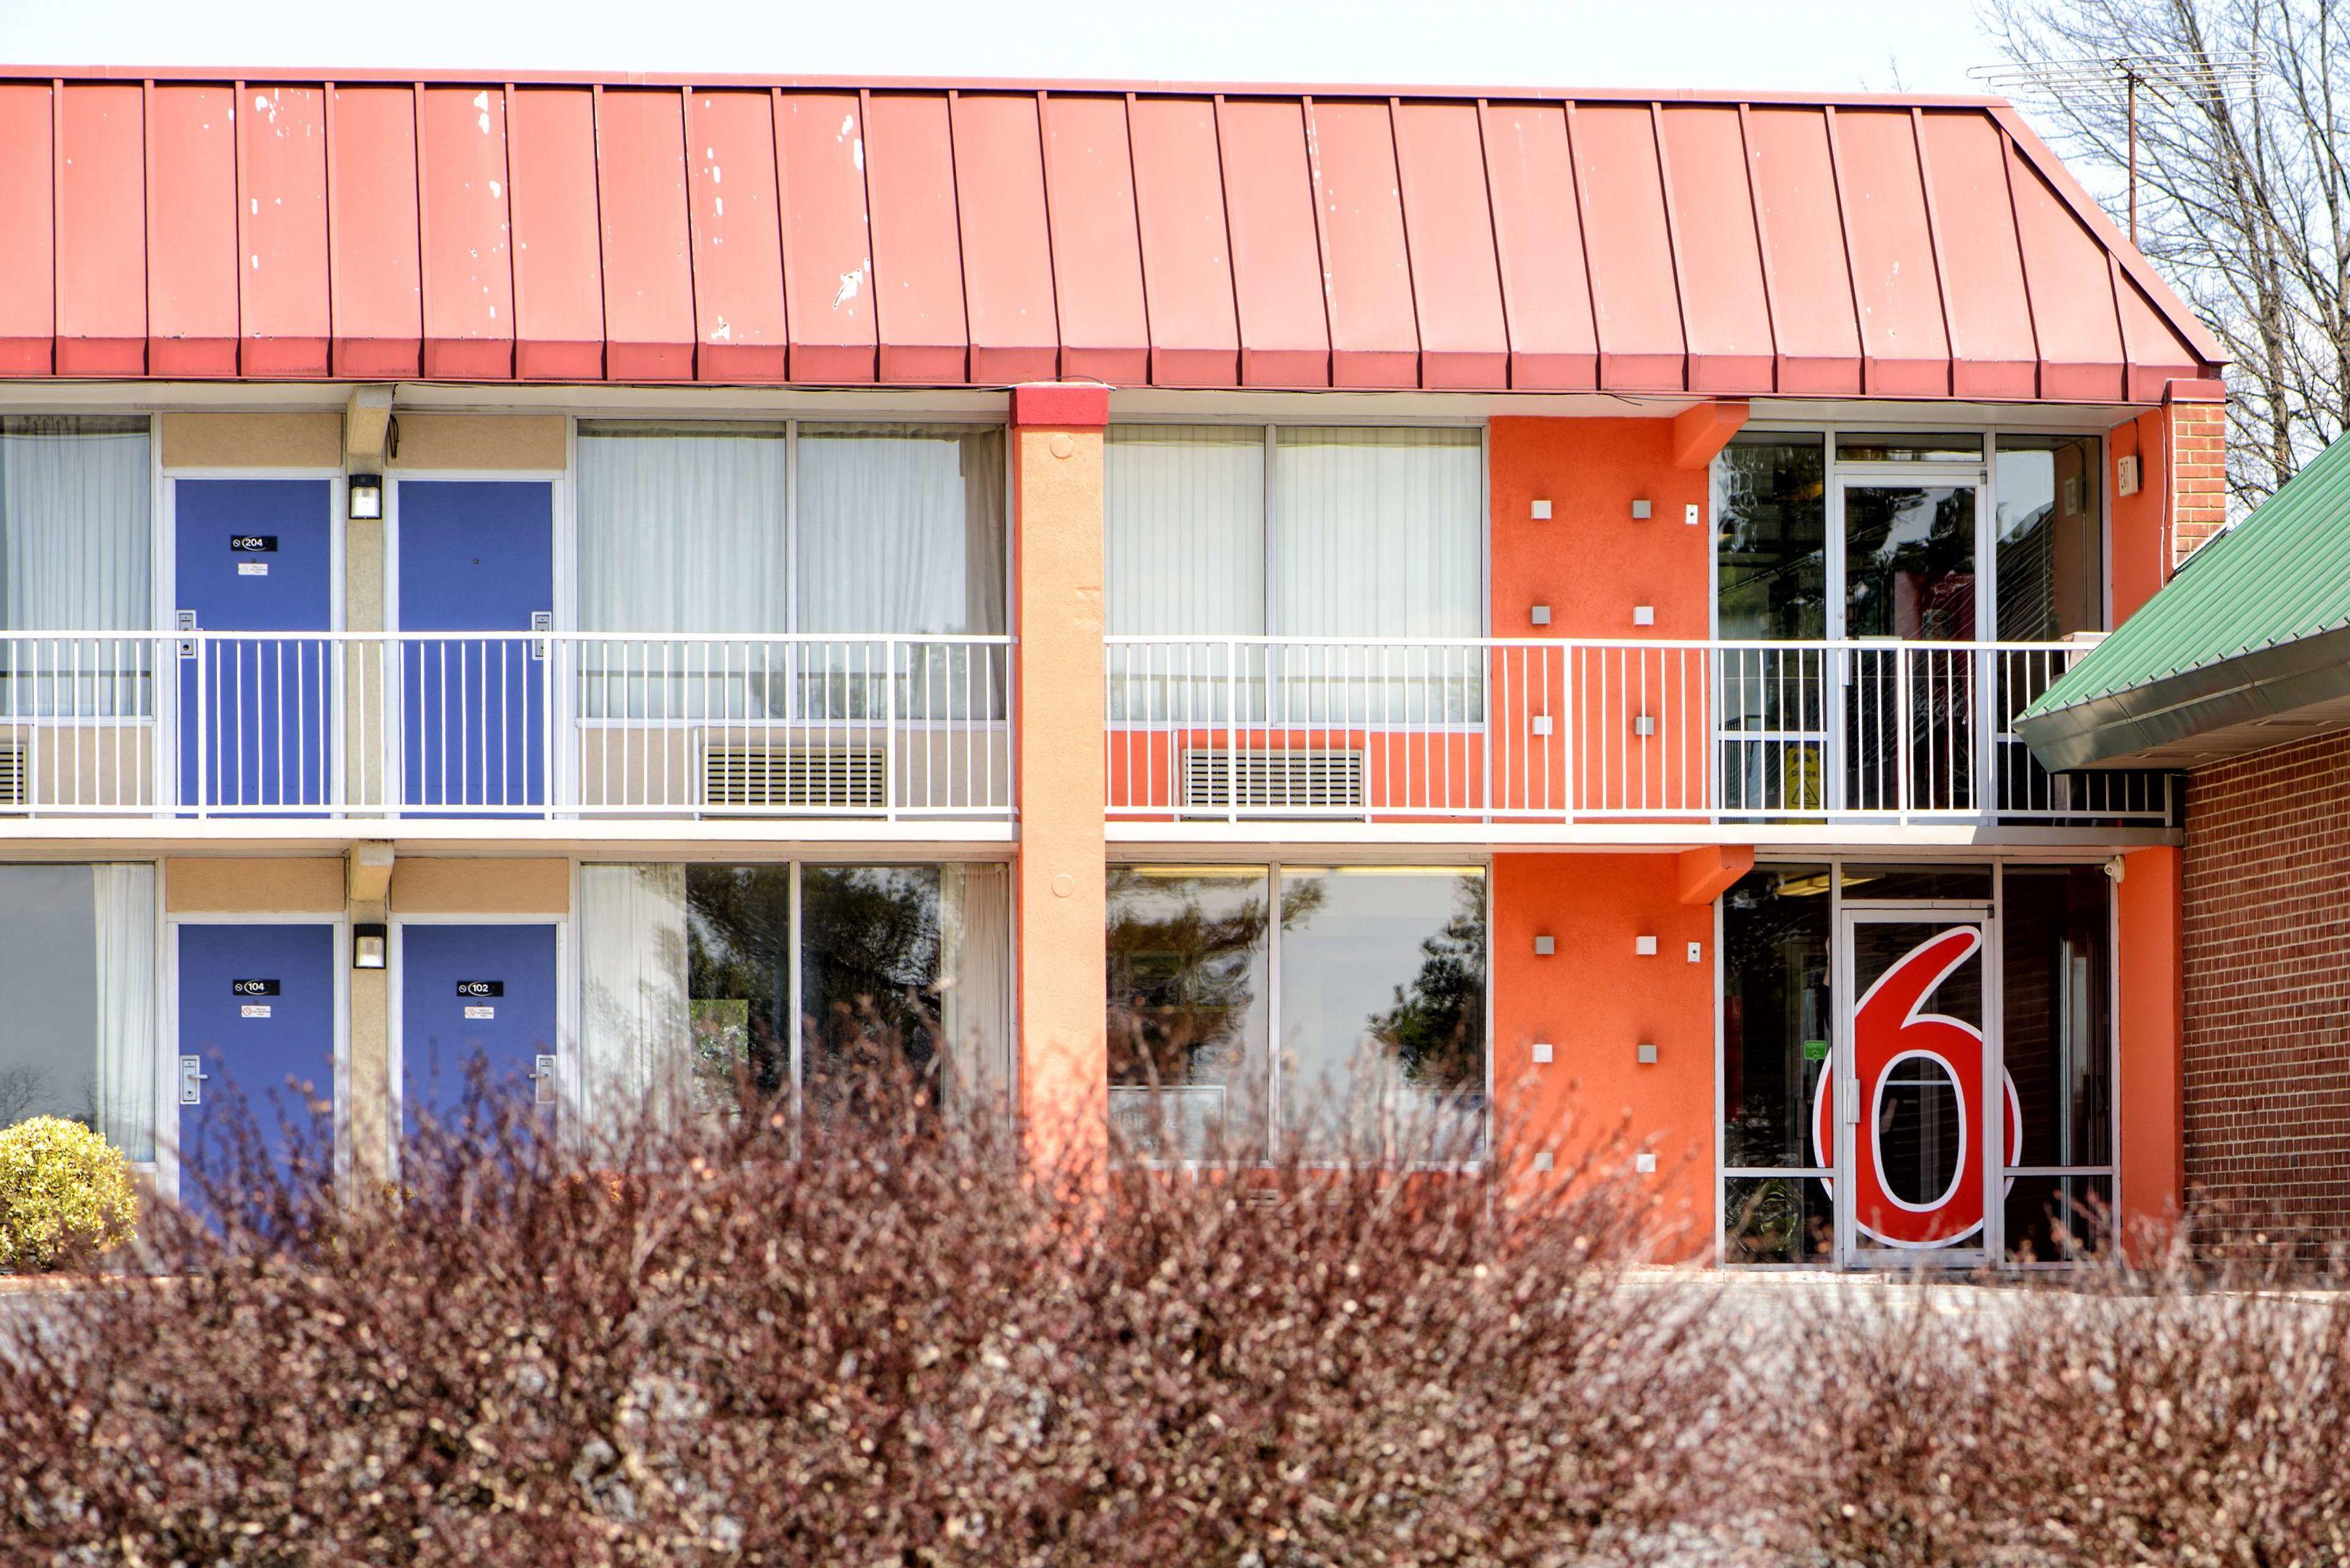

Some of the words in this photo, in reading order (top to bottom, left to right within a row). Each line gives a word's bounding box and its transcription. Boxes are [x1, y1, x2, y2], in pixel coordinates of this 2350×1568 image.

[245, 538, 263, 547] 204
[1912, 693, 1964, 718] CocCola
[248, 982, 265, 991] 104
[472, 984, 489, 992] 102
[1813, 926, 2022, 1249] 6
